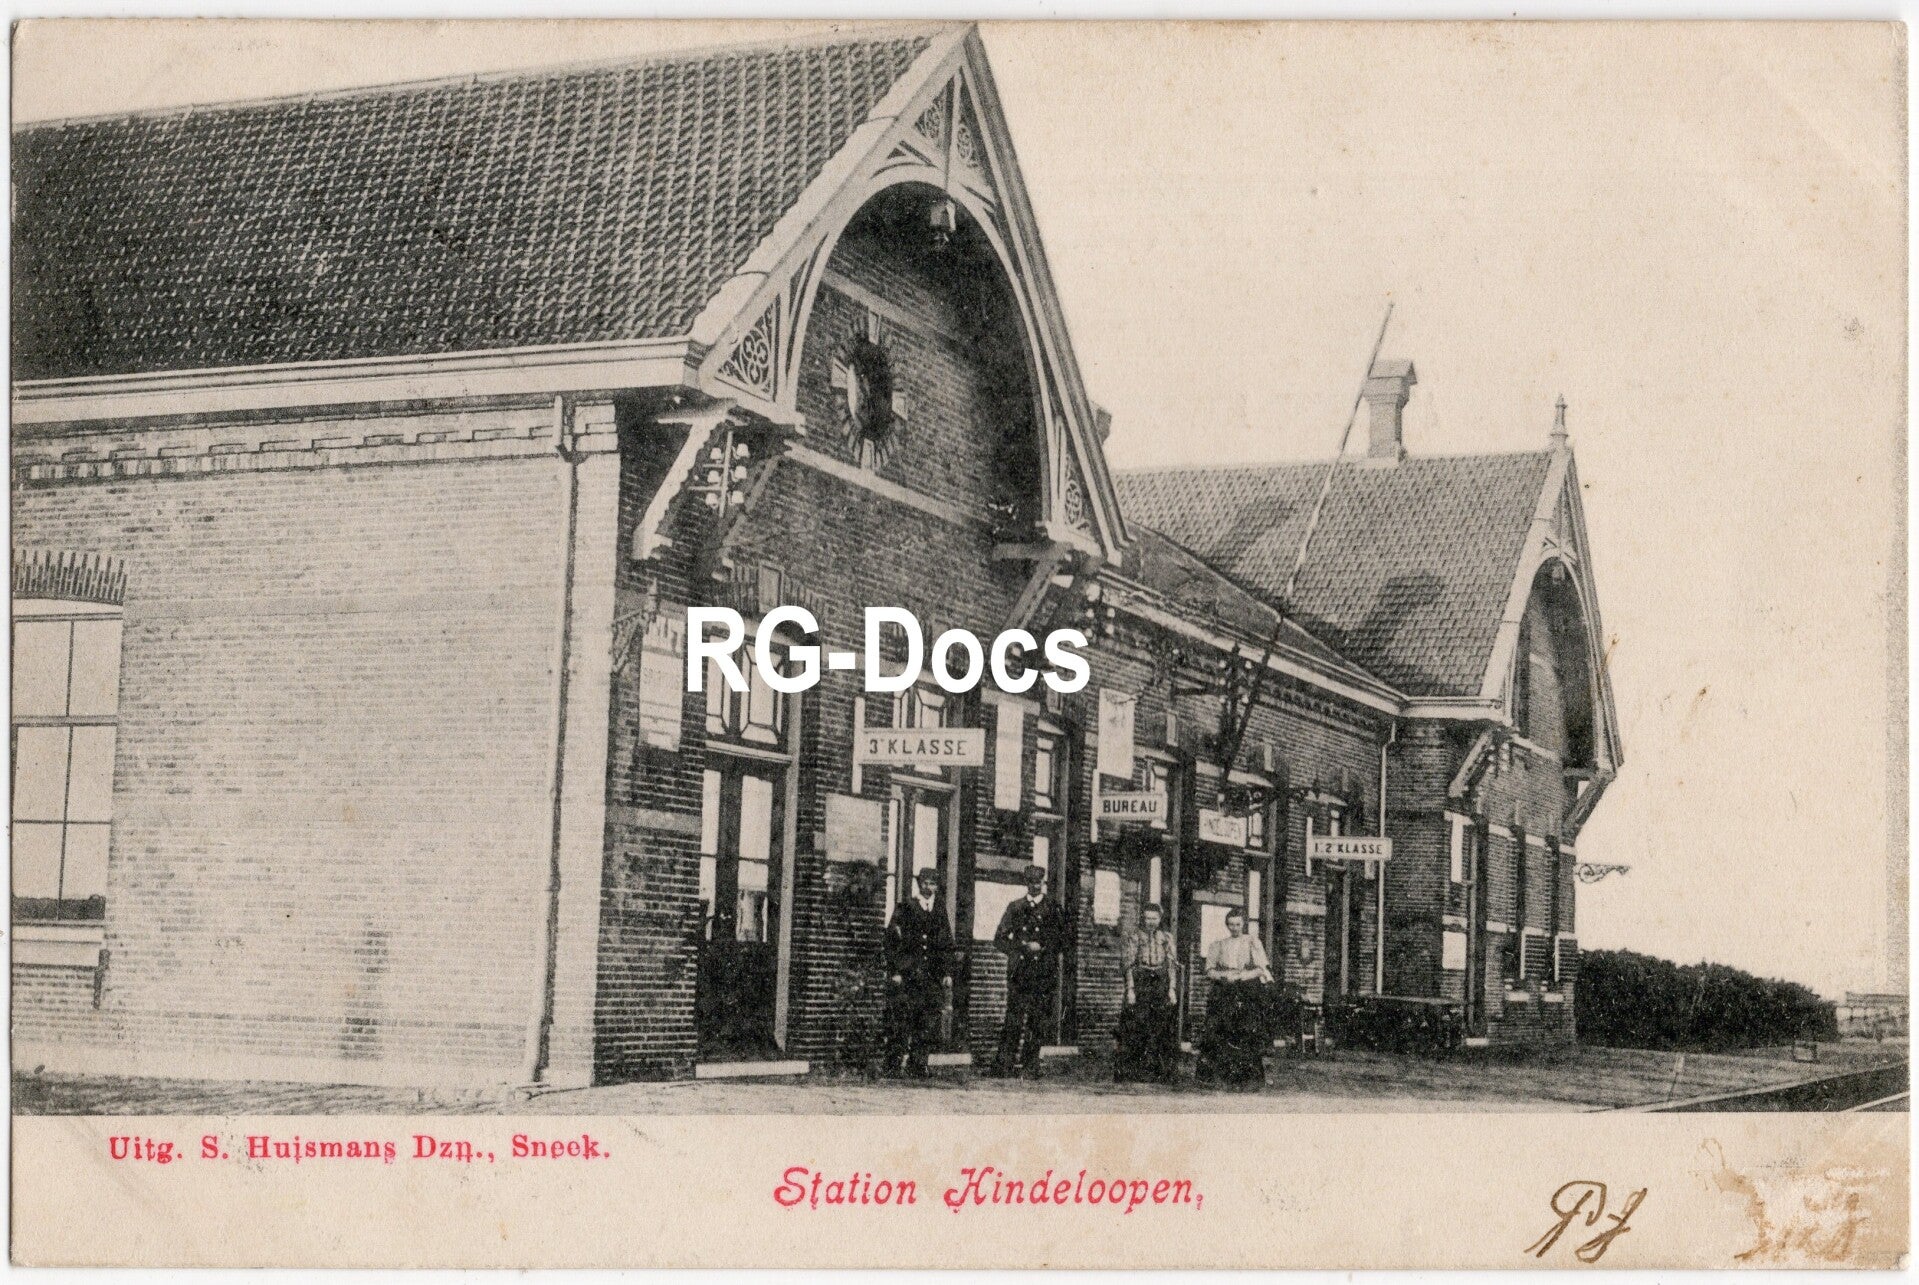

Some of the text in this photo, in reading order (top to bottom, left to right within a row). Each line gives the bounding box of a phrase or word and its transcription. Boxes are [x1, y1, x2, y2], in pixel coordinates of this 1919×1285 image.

[888, 739, 968, 756] KLASSE
[1103, 799, 1157, 813] BUREAU
[1337, 843, 1383, 855] KLASSE
[108, 1135, 183, 1165] Uitg.
[201, 1135, 229, 1160] S.
[247, 1135, 396, 1163] Huismans
[512, 1134, 610, 1160] Sneek.
[773, 1166, 917, 1211] Station
